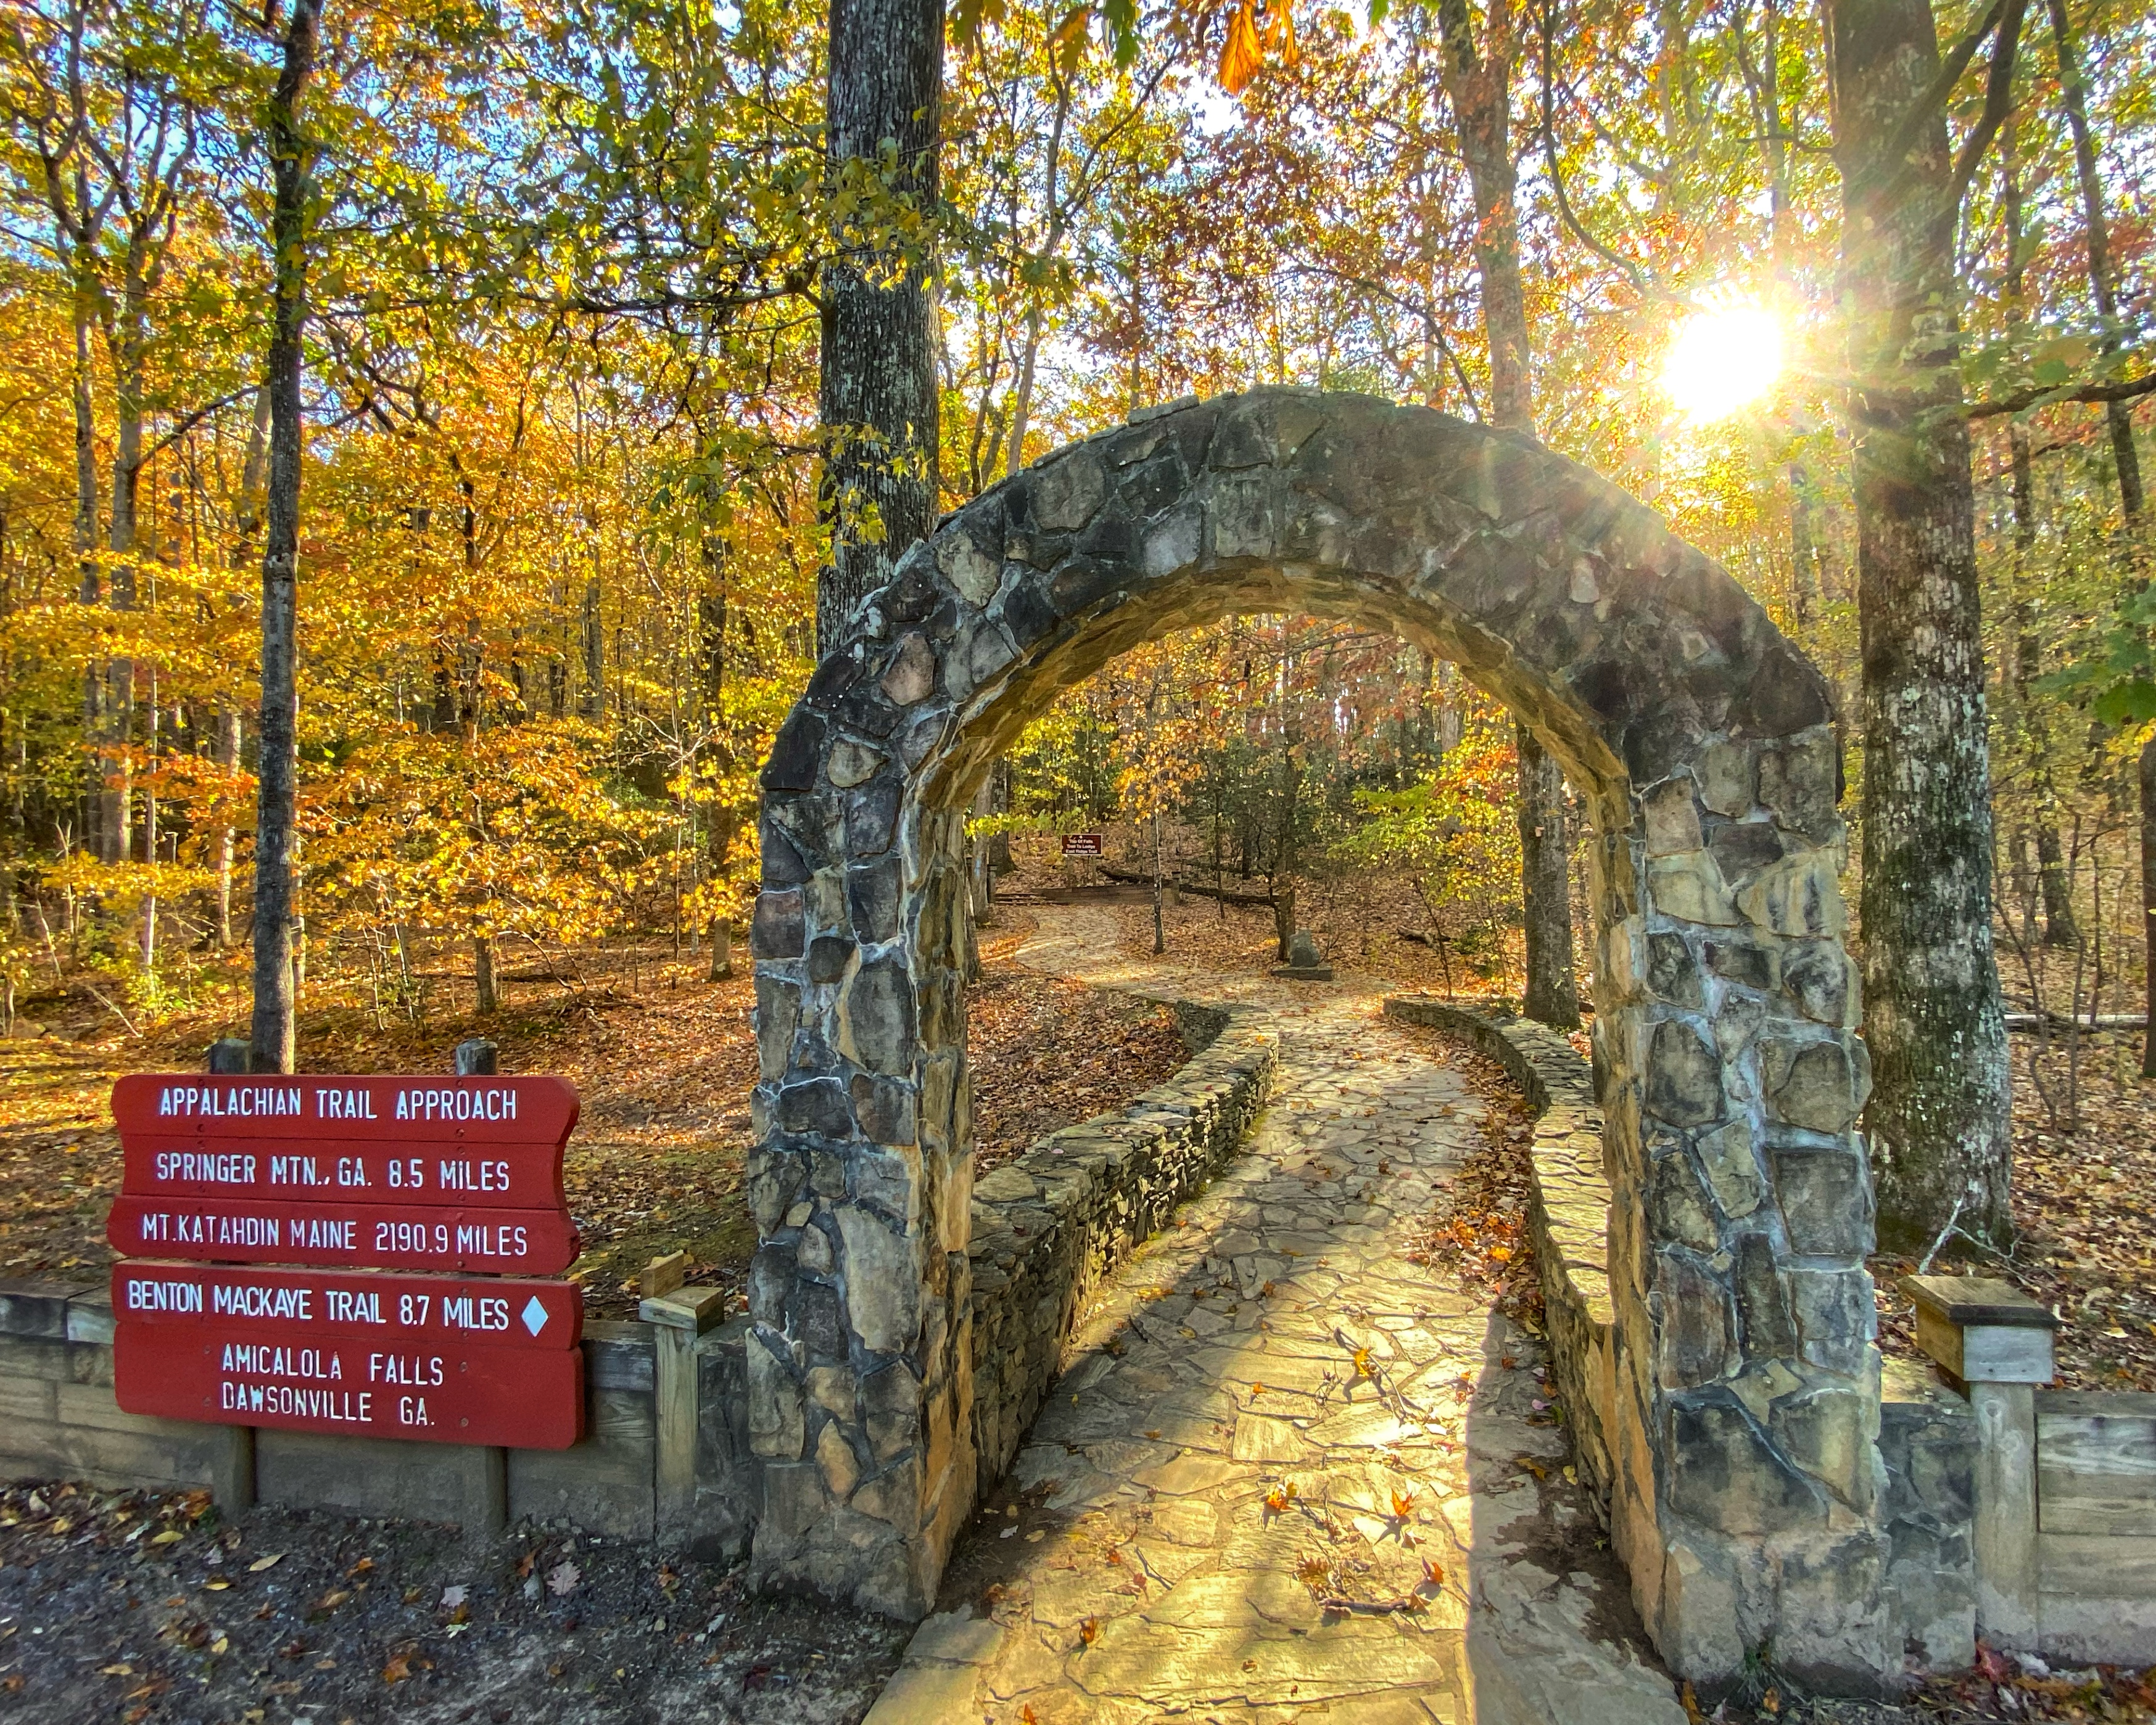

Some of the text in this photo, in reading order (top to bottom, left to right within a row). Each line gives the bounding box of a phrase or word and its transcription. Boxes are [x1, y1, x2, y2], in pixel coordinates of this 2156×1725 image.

[160, 1087, 516, 1121] APPALACHIAN TRAIL APPROACH
[157, 1152, 256, 1183] SPRINGER
[389, 1158, 423, 1188] 8.5
[440, 1160, 510, 1191] MILES
[291, 1219, 357, 1250] MAINE
[376, 1222, 448, 1253] 2190.9
[457, 1225, 527, 1256] MILES
[128, 1280, 509, 1331] BENTON MACKAYE TRAIL 8.7 MILES
[222, 1343, 444, 1386] AMICALOLA FALLS
[222, 1381, 435, 1426] DAWSONVILLE GA.
